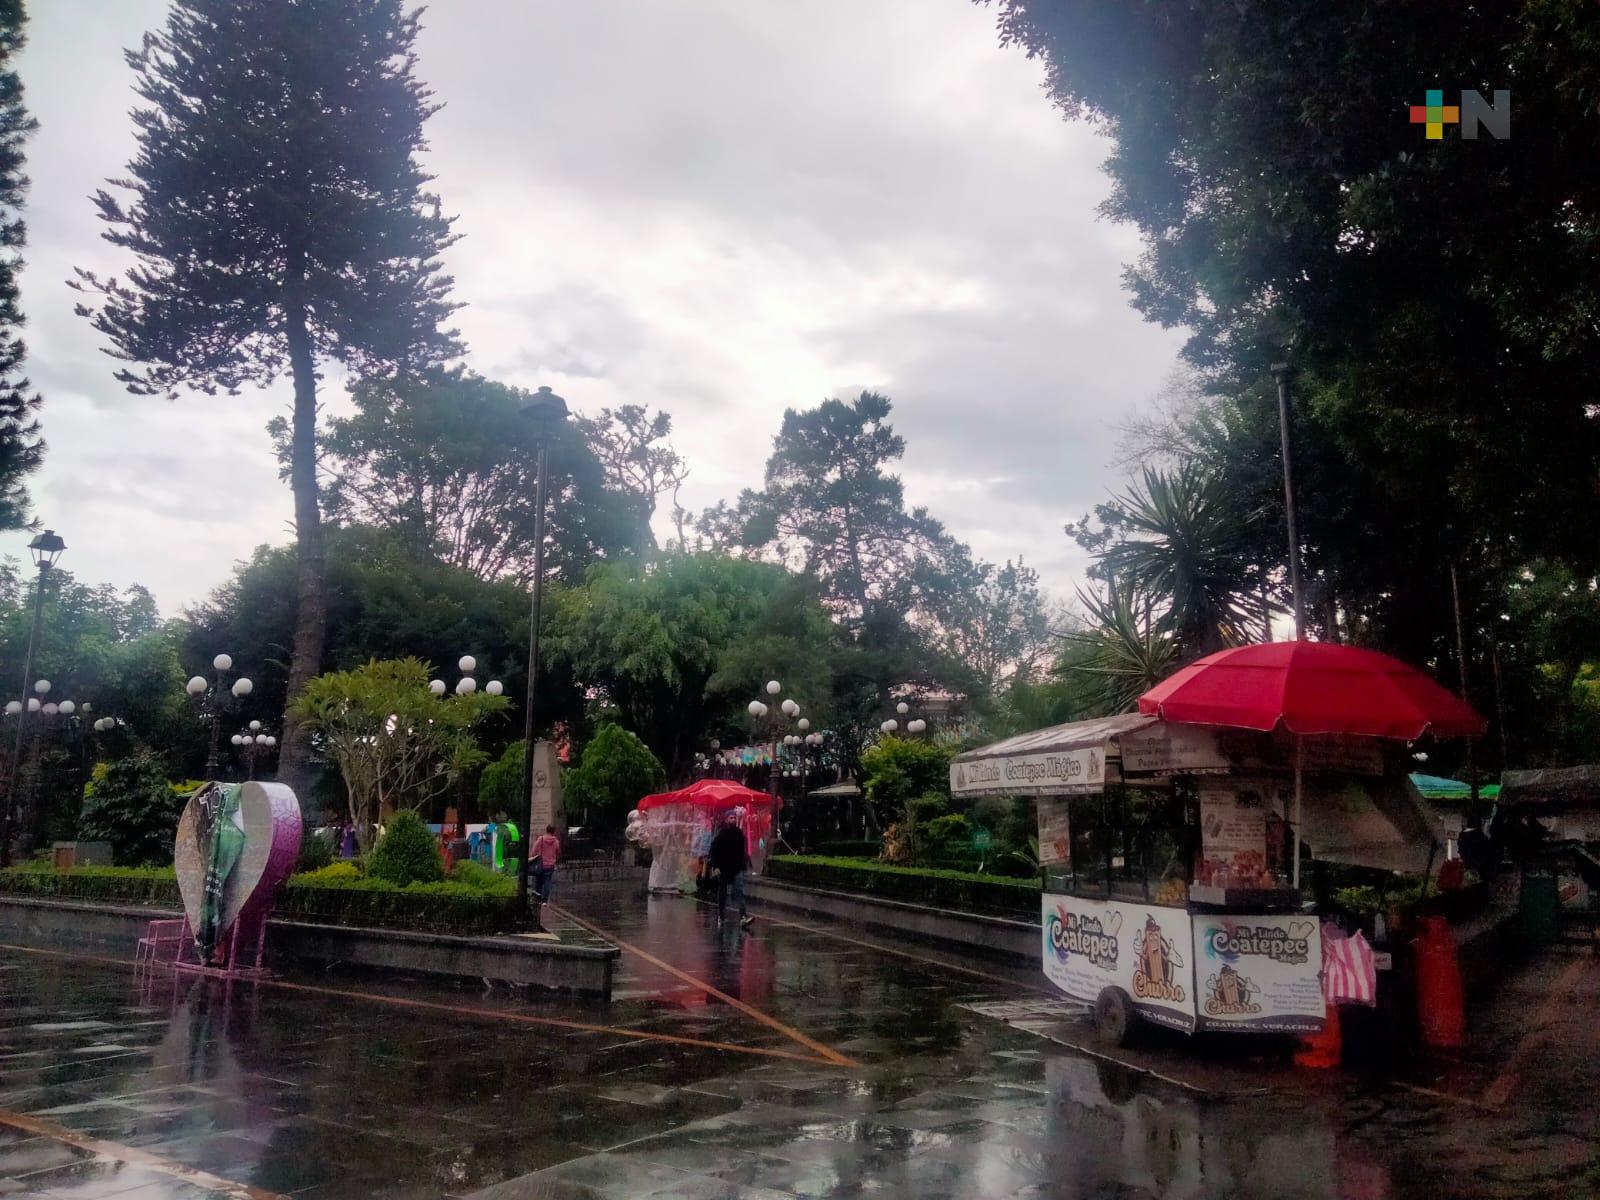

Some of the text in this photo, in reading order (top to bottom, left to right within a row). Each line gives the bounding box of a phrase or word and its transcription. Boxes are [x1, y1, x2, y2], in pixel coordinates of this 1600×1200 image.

[1006, 760, 1045, 782] Coatepec
[1052, 920, 1118, 963] Coatepec
[1212, 930, 1308, 959] Coatepec
[1133, 970, 1185, 1003] Churro
